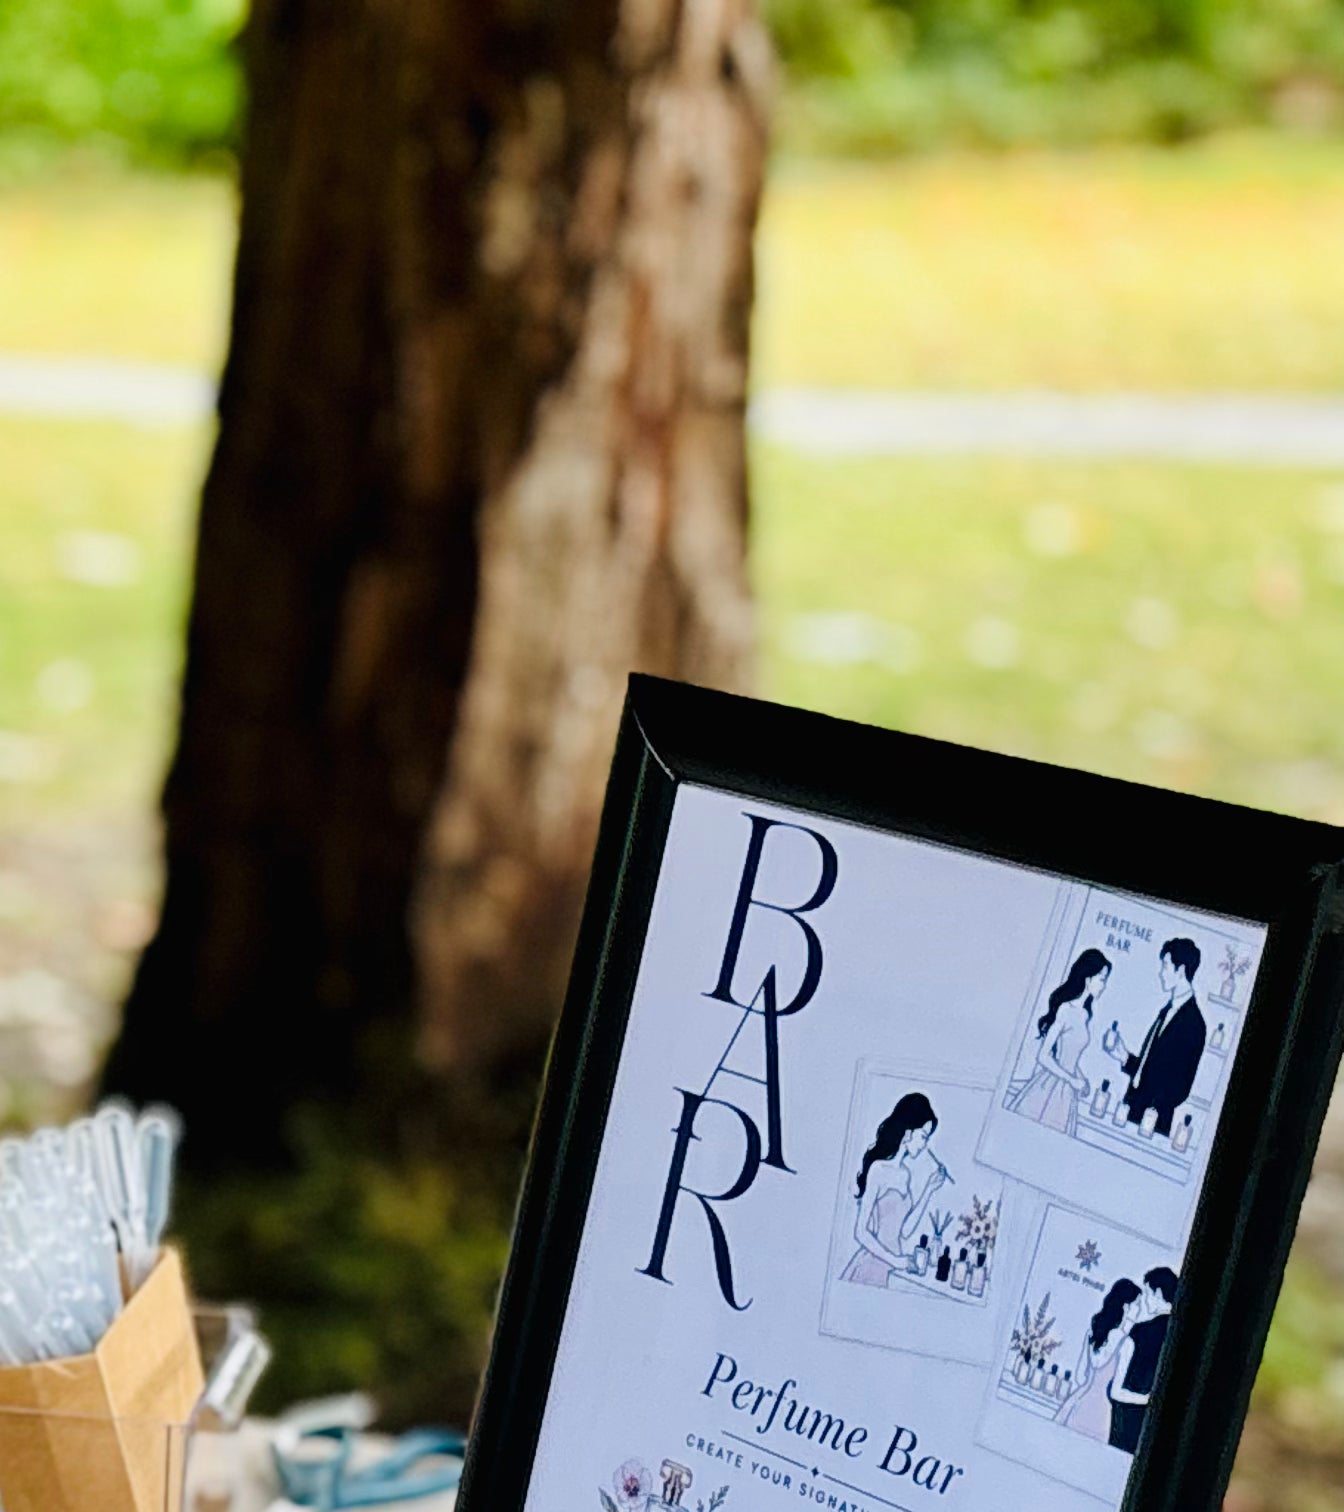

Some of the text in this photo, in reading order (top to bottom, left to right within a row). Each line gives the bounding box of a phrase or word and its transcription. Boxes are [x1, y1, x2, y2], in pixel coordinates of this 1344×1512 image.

[1096, 911, 1153, 942] PERFUME
[1106, 933, 1131, 952] BAR
[634, 812, 838, 1311] BAR
[701, 1352, 963, 1495] Perfume Bar
[686, 1433, 743, 1468] CREATE
[750, 1462, 792, 1490] YOUR
